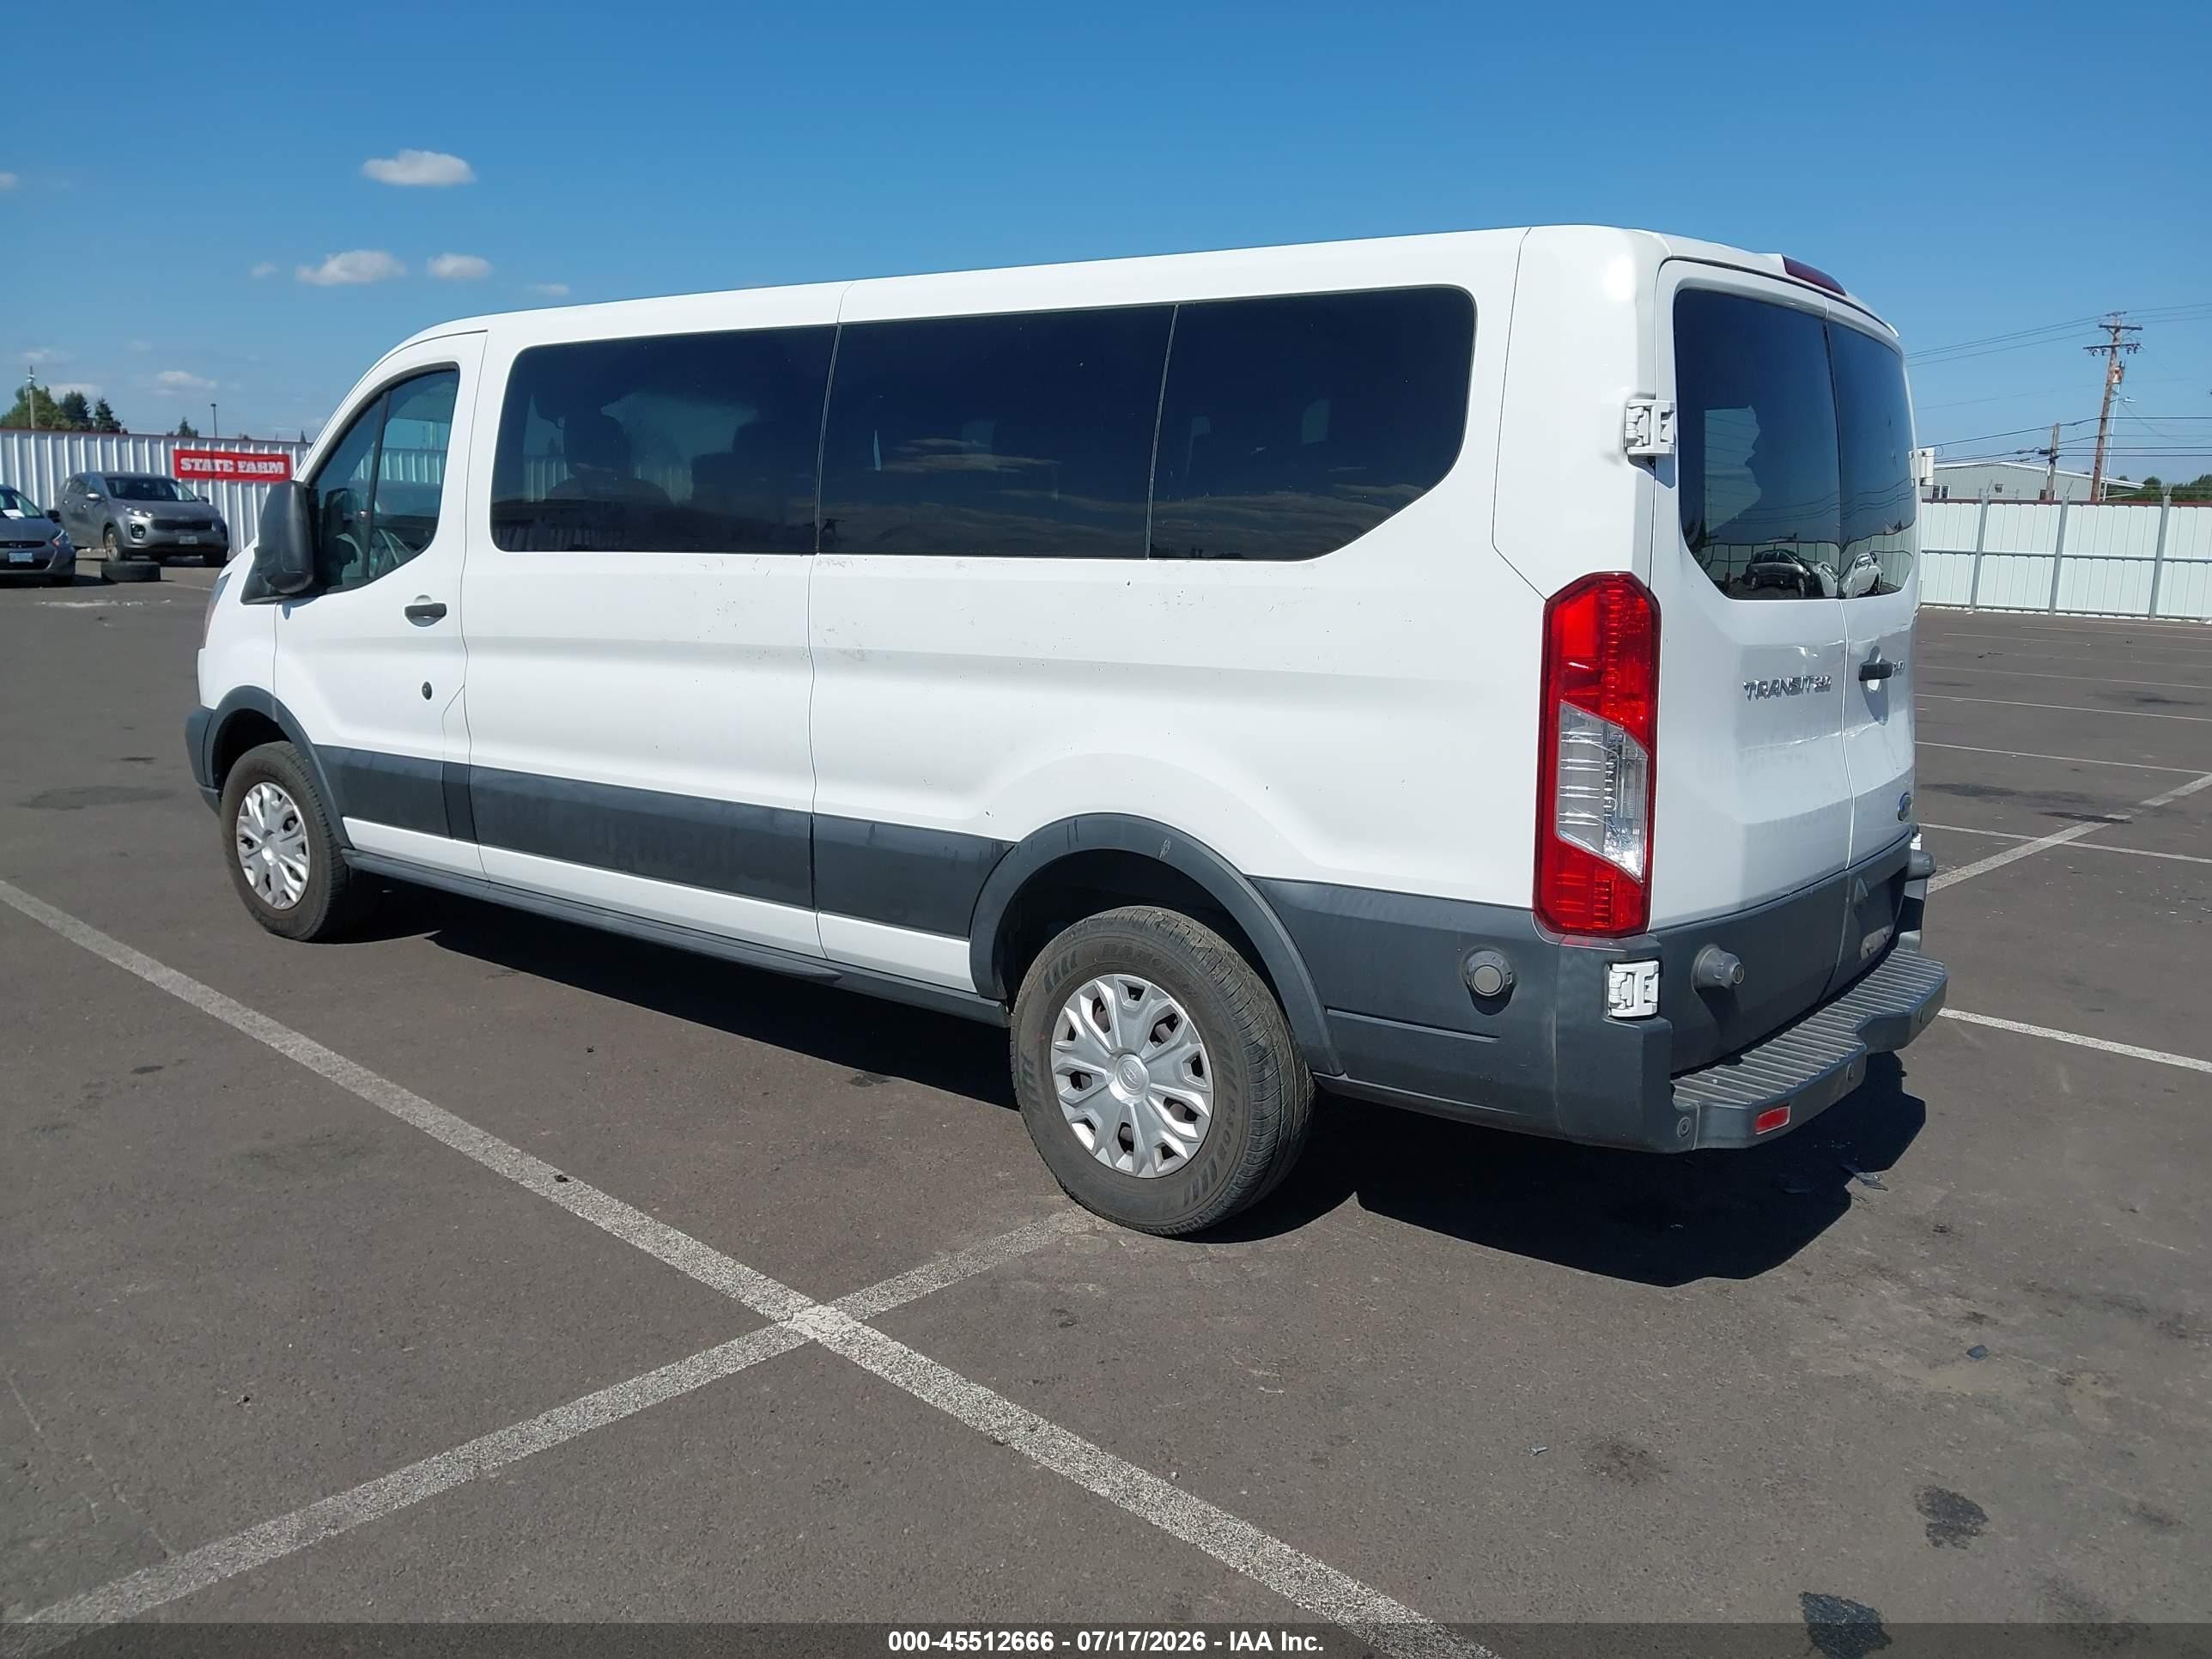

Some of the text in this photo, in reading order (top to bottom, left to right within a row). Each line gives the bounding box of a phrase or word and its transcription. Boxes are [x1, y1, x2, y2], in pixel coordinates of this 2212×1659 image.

[180, 458, 285, 474] STATE FARM
[1742, 676, 1814, 701] TRANSIT
